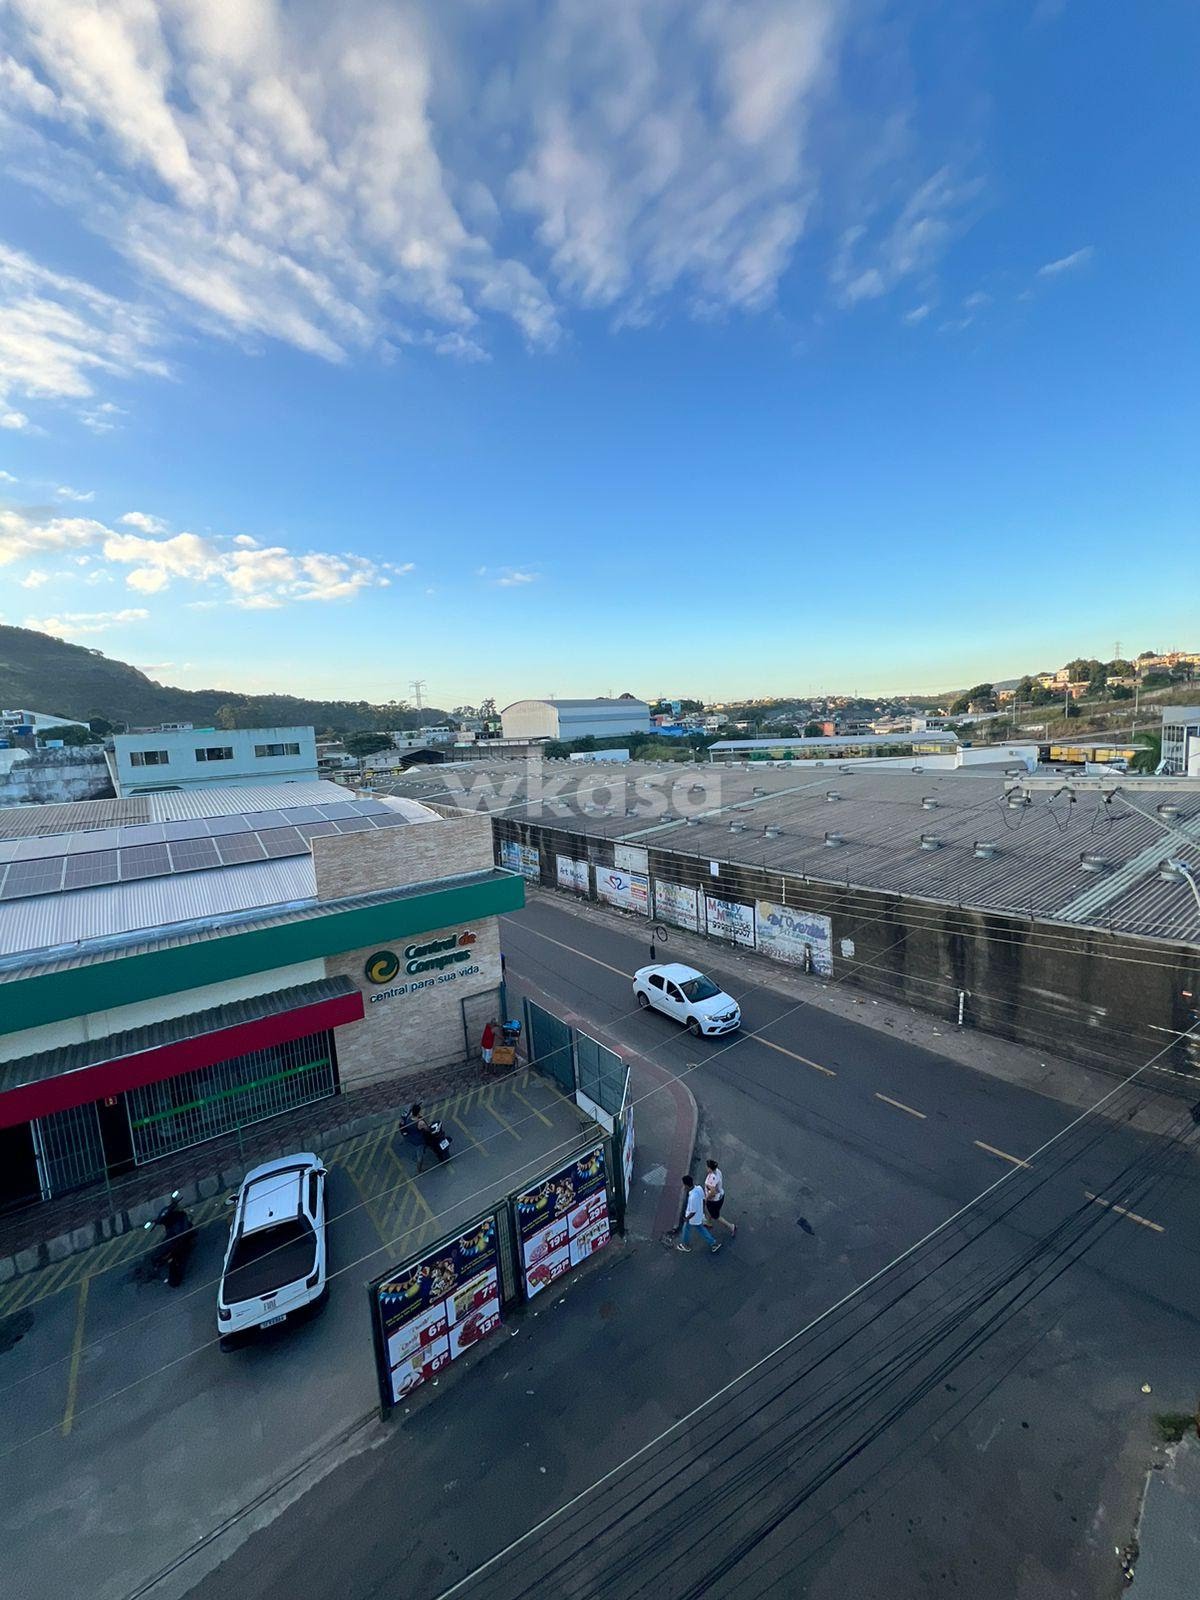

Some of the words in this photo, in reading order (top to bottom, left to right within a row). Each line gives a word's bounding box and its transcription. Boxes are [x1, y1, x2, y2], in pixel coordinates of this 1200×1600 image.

[405, 933, 457, 959] Central
[459, 929, 477, 946] de
[406, 948, 471, 975] Compras
[370, 984, 408, 1003] central
[411, 978, 435, 993] para
[437, 973, 457, 984] sua
[459, 965, 480, 977] vida
